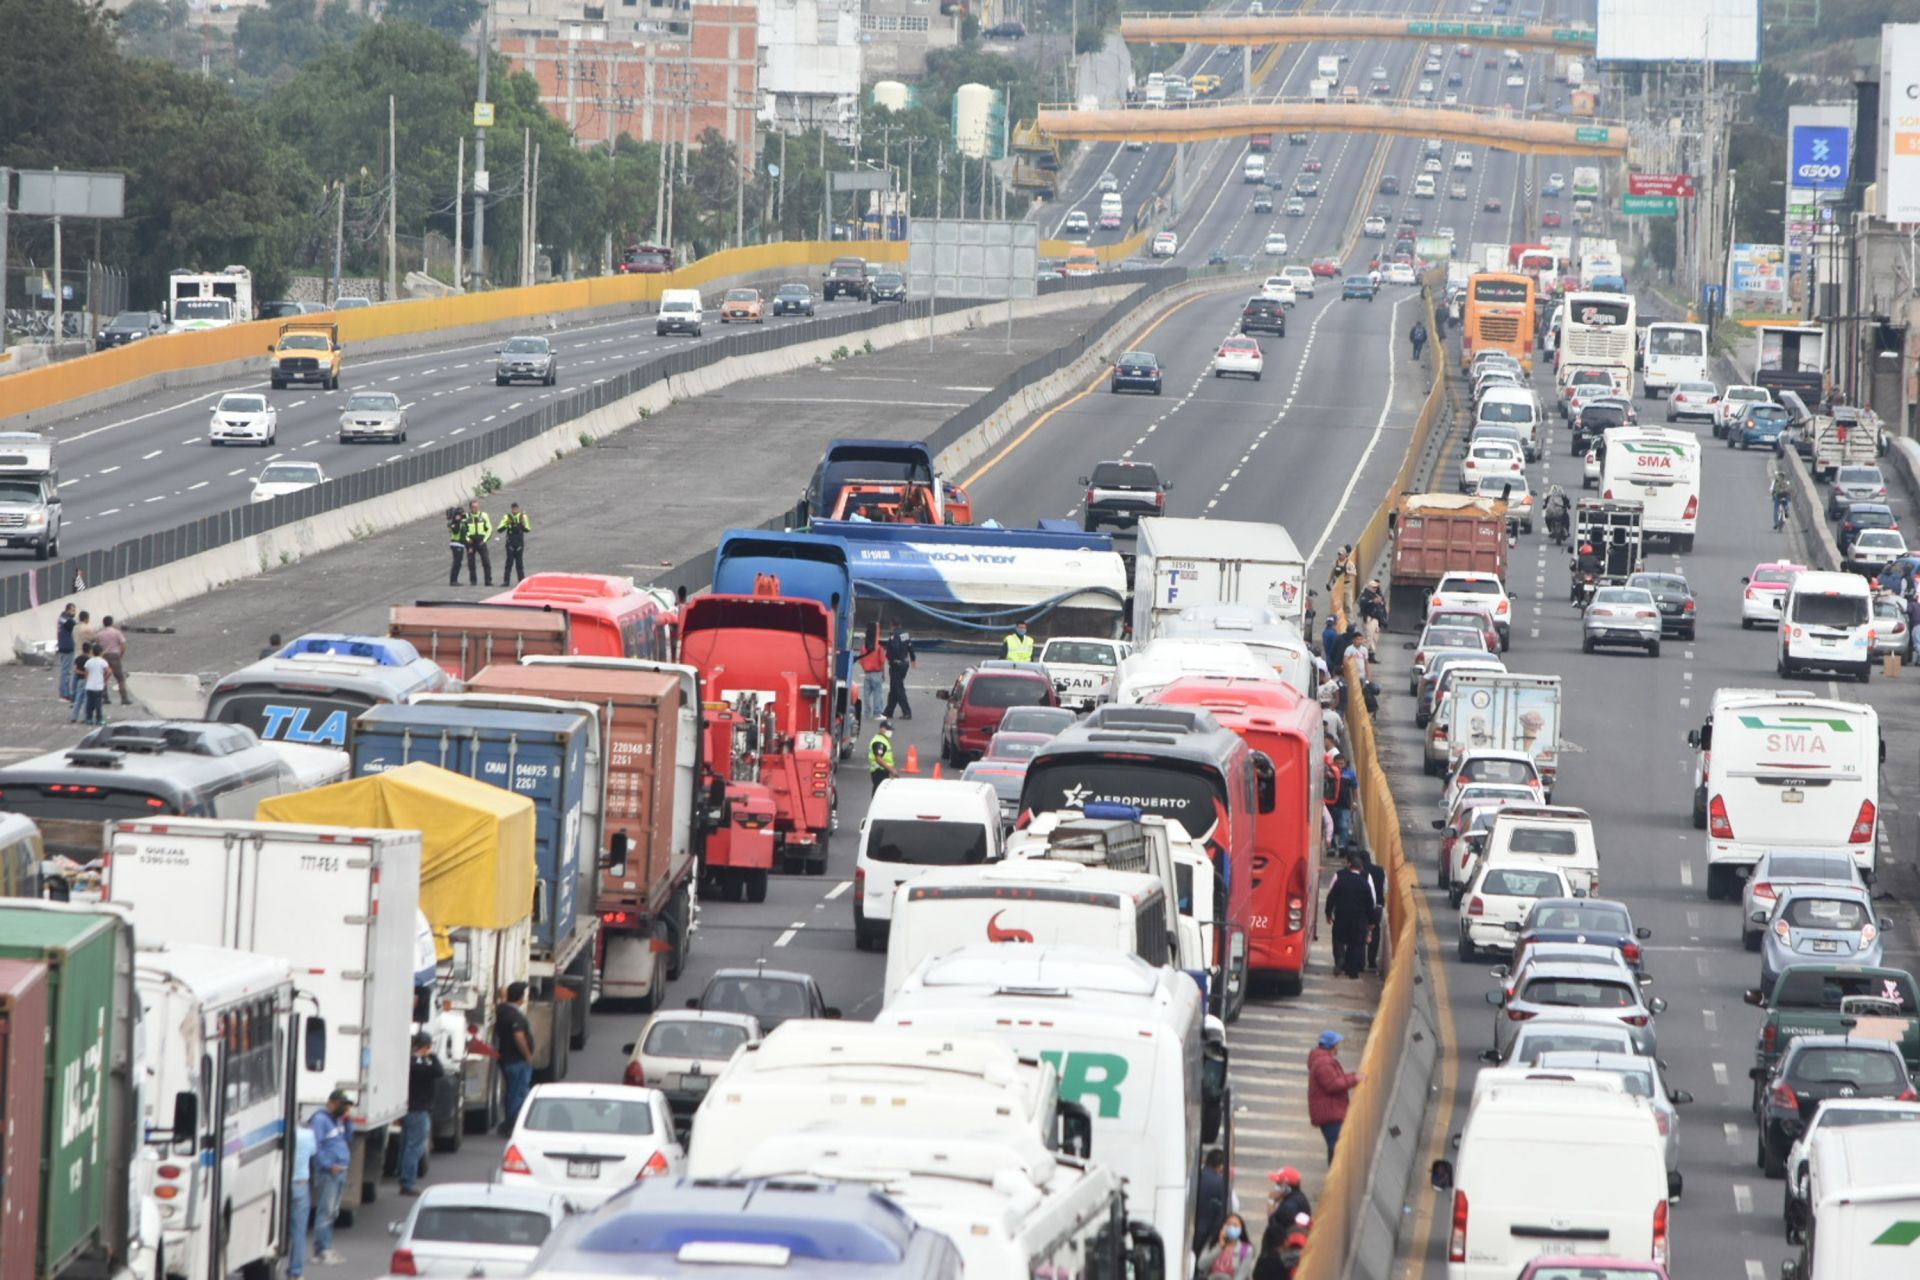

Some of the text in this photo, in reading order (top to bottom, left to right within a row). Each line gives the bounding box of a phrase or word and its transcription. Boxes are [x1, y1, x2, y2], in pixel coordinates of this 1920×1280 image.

[1638, 456, 1671, 468] SMA
[261, 705, 347, 745] TLA
[1766, 734, 1827, 753] SMA
[485, 761, 507, 773] CMAU
[1095, 795, 1186, 809] AEROPUERTO
[1250, 915, 1268, 928] 722
